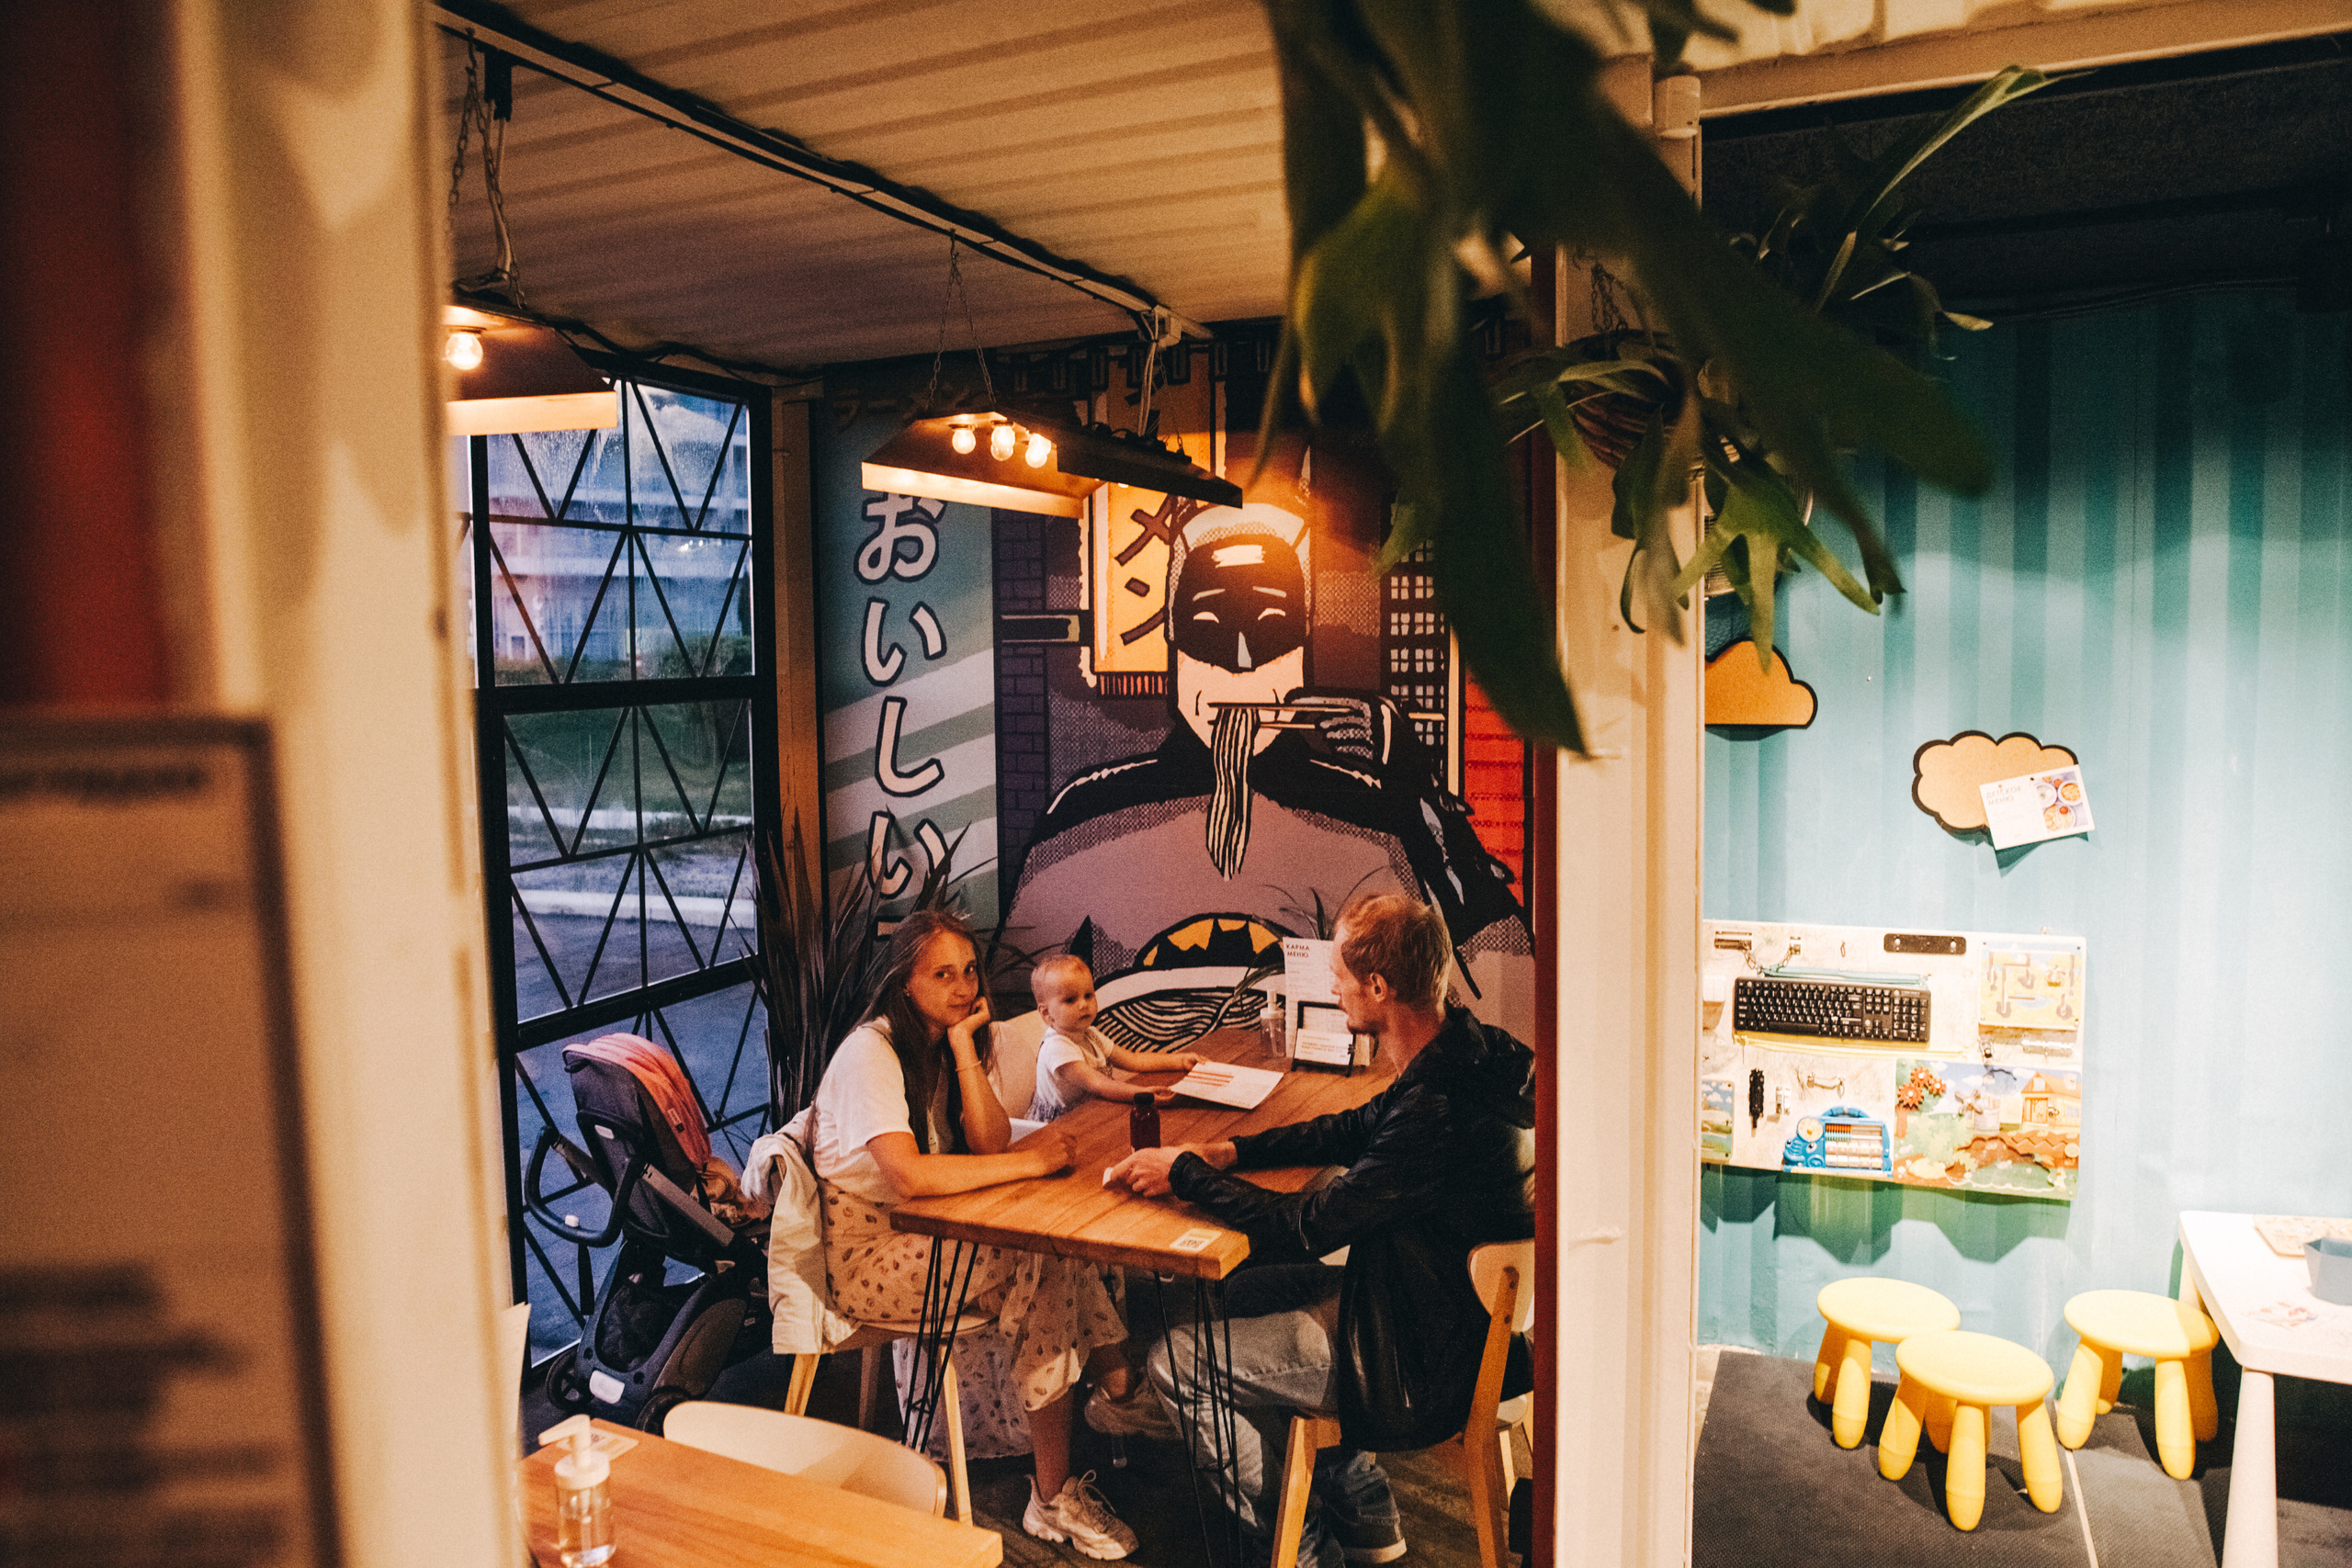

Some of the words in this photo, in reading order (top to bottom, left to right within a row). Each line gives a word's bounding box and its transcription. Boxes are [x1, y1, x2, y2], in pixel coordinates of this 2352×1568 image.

[854, 489, 952, 942] おいしい
[1988, 795, 2014, 807] МЕНЮ
[1286, 943, 1310, 952] КАРМА
